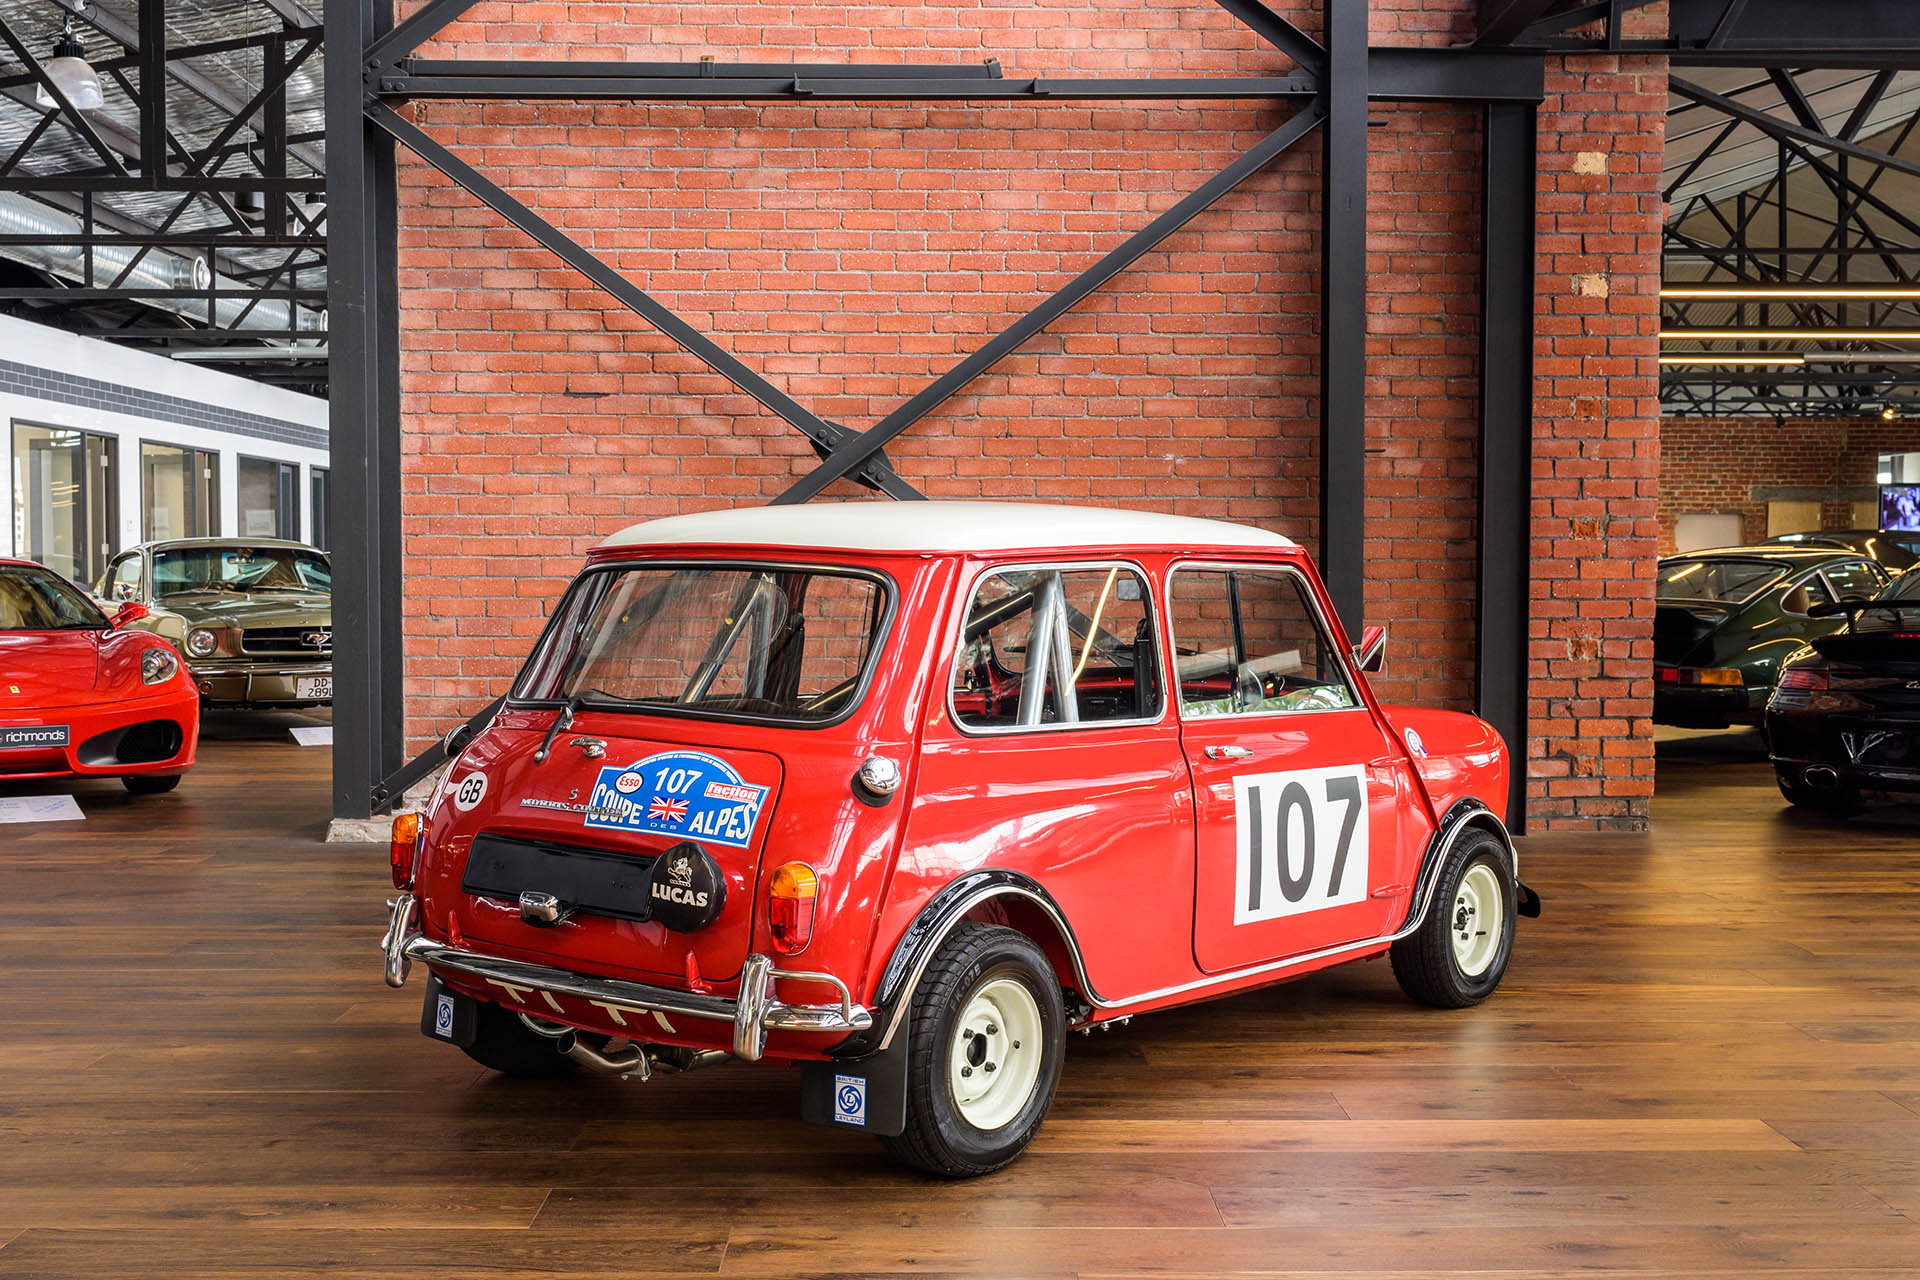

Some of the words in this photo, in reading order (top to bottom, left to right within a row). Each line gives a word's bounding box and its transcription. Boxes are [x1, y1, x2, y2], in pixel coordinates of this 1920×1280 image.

[5, 730, 65, 743] richmonds
[459, 779, 483, 803] GB
[655, 767, 703, 794] 107
[520, 798, 569, 811] MORRIS
[590, 783, 644, 825] COUPE
[650, 822, 677, 830] DES
[688, 803, 758, 839] ALPES
[1248, 776, 1361, 911] 107
[652, 882, 708, 907] LUCAS
